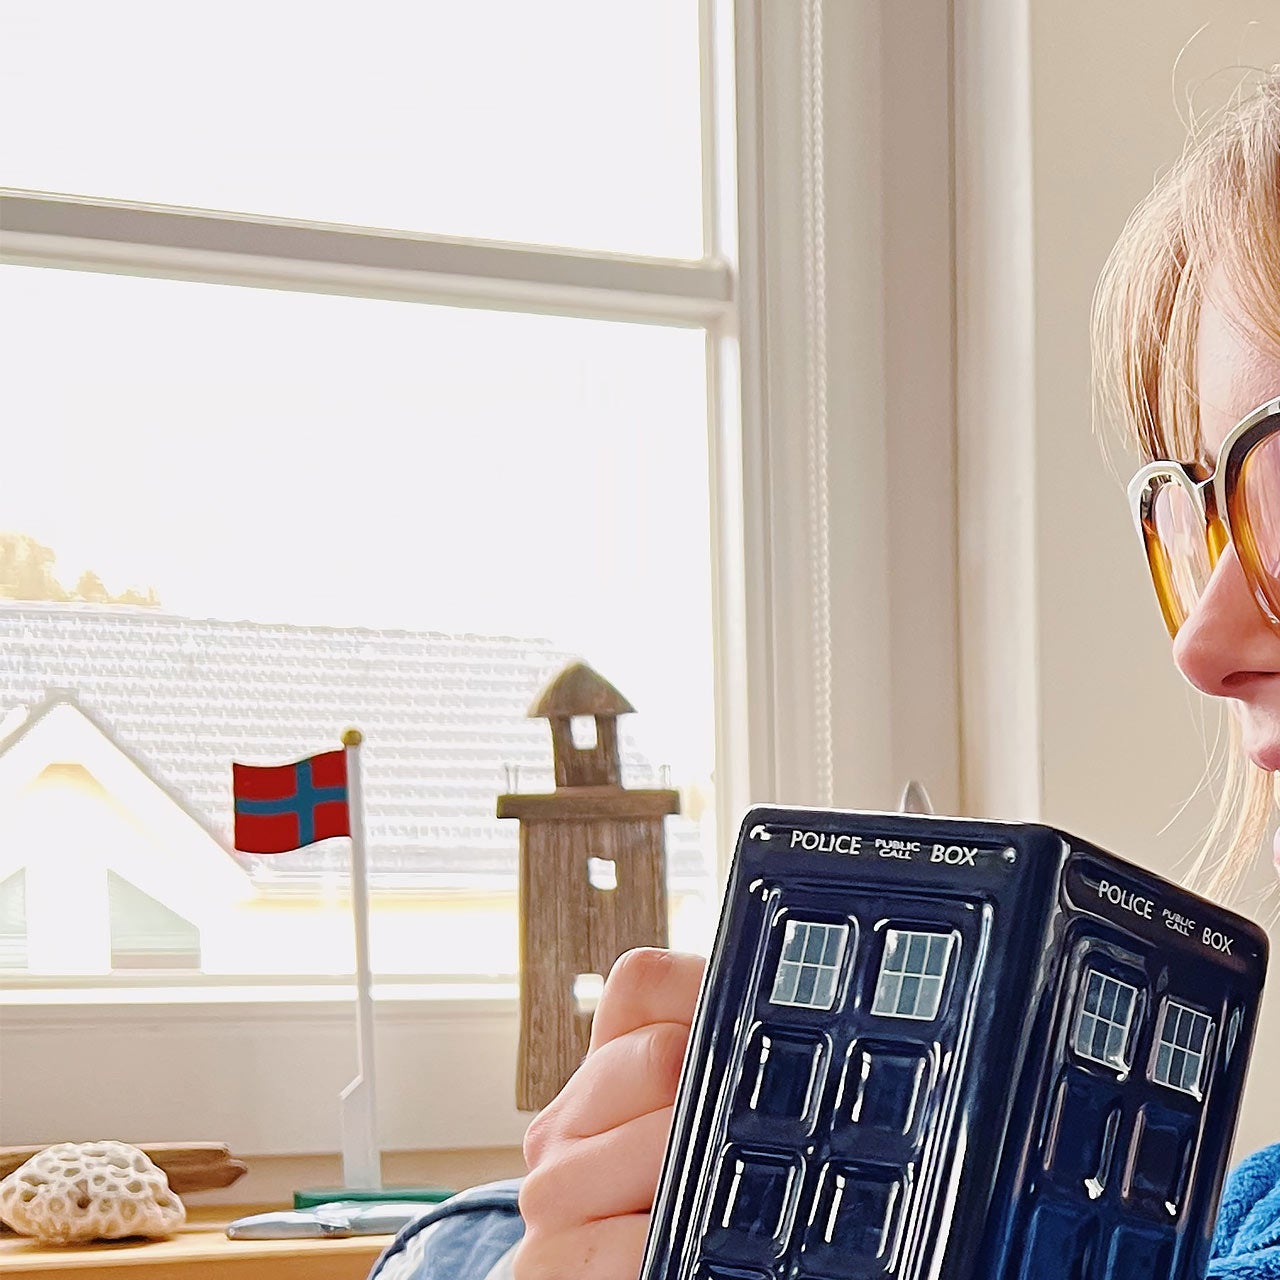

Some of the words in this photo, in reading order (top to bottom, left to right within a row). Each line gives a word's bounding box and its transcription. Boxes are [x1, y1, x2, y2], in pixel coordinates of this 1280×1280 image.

[789, 830, 862, 855] POLICE
[875, 839, 921, 852] PUBLIC
[879, 848, 913, 860] CALL
[930, 843, 979, 867] BOX
[1097, 879, 1155, 920] POLICE
[1162, 908, 1196, 930] PUBLIC
[1165, 919, 1190, 937] CALL
[1202, 927, 1235, 956] BOX
